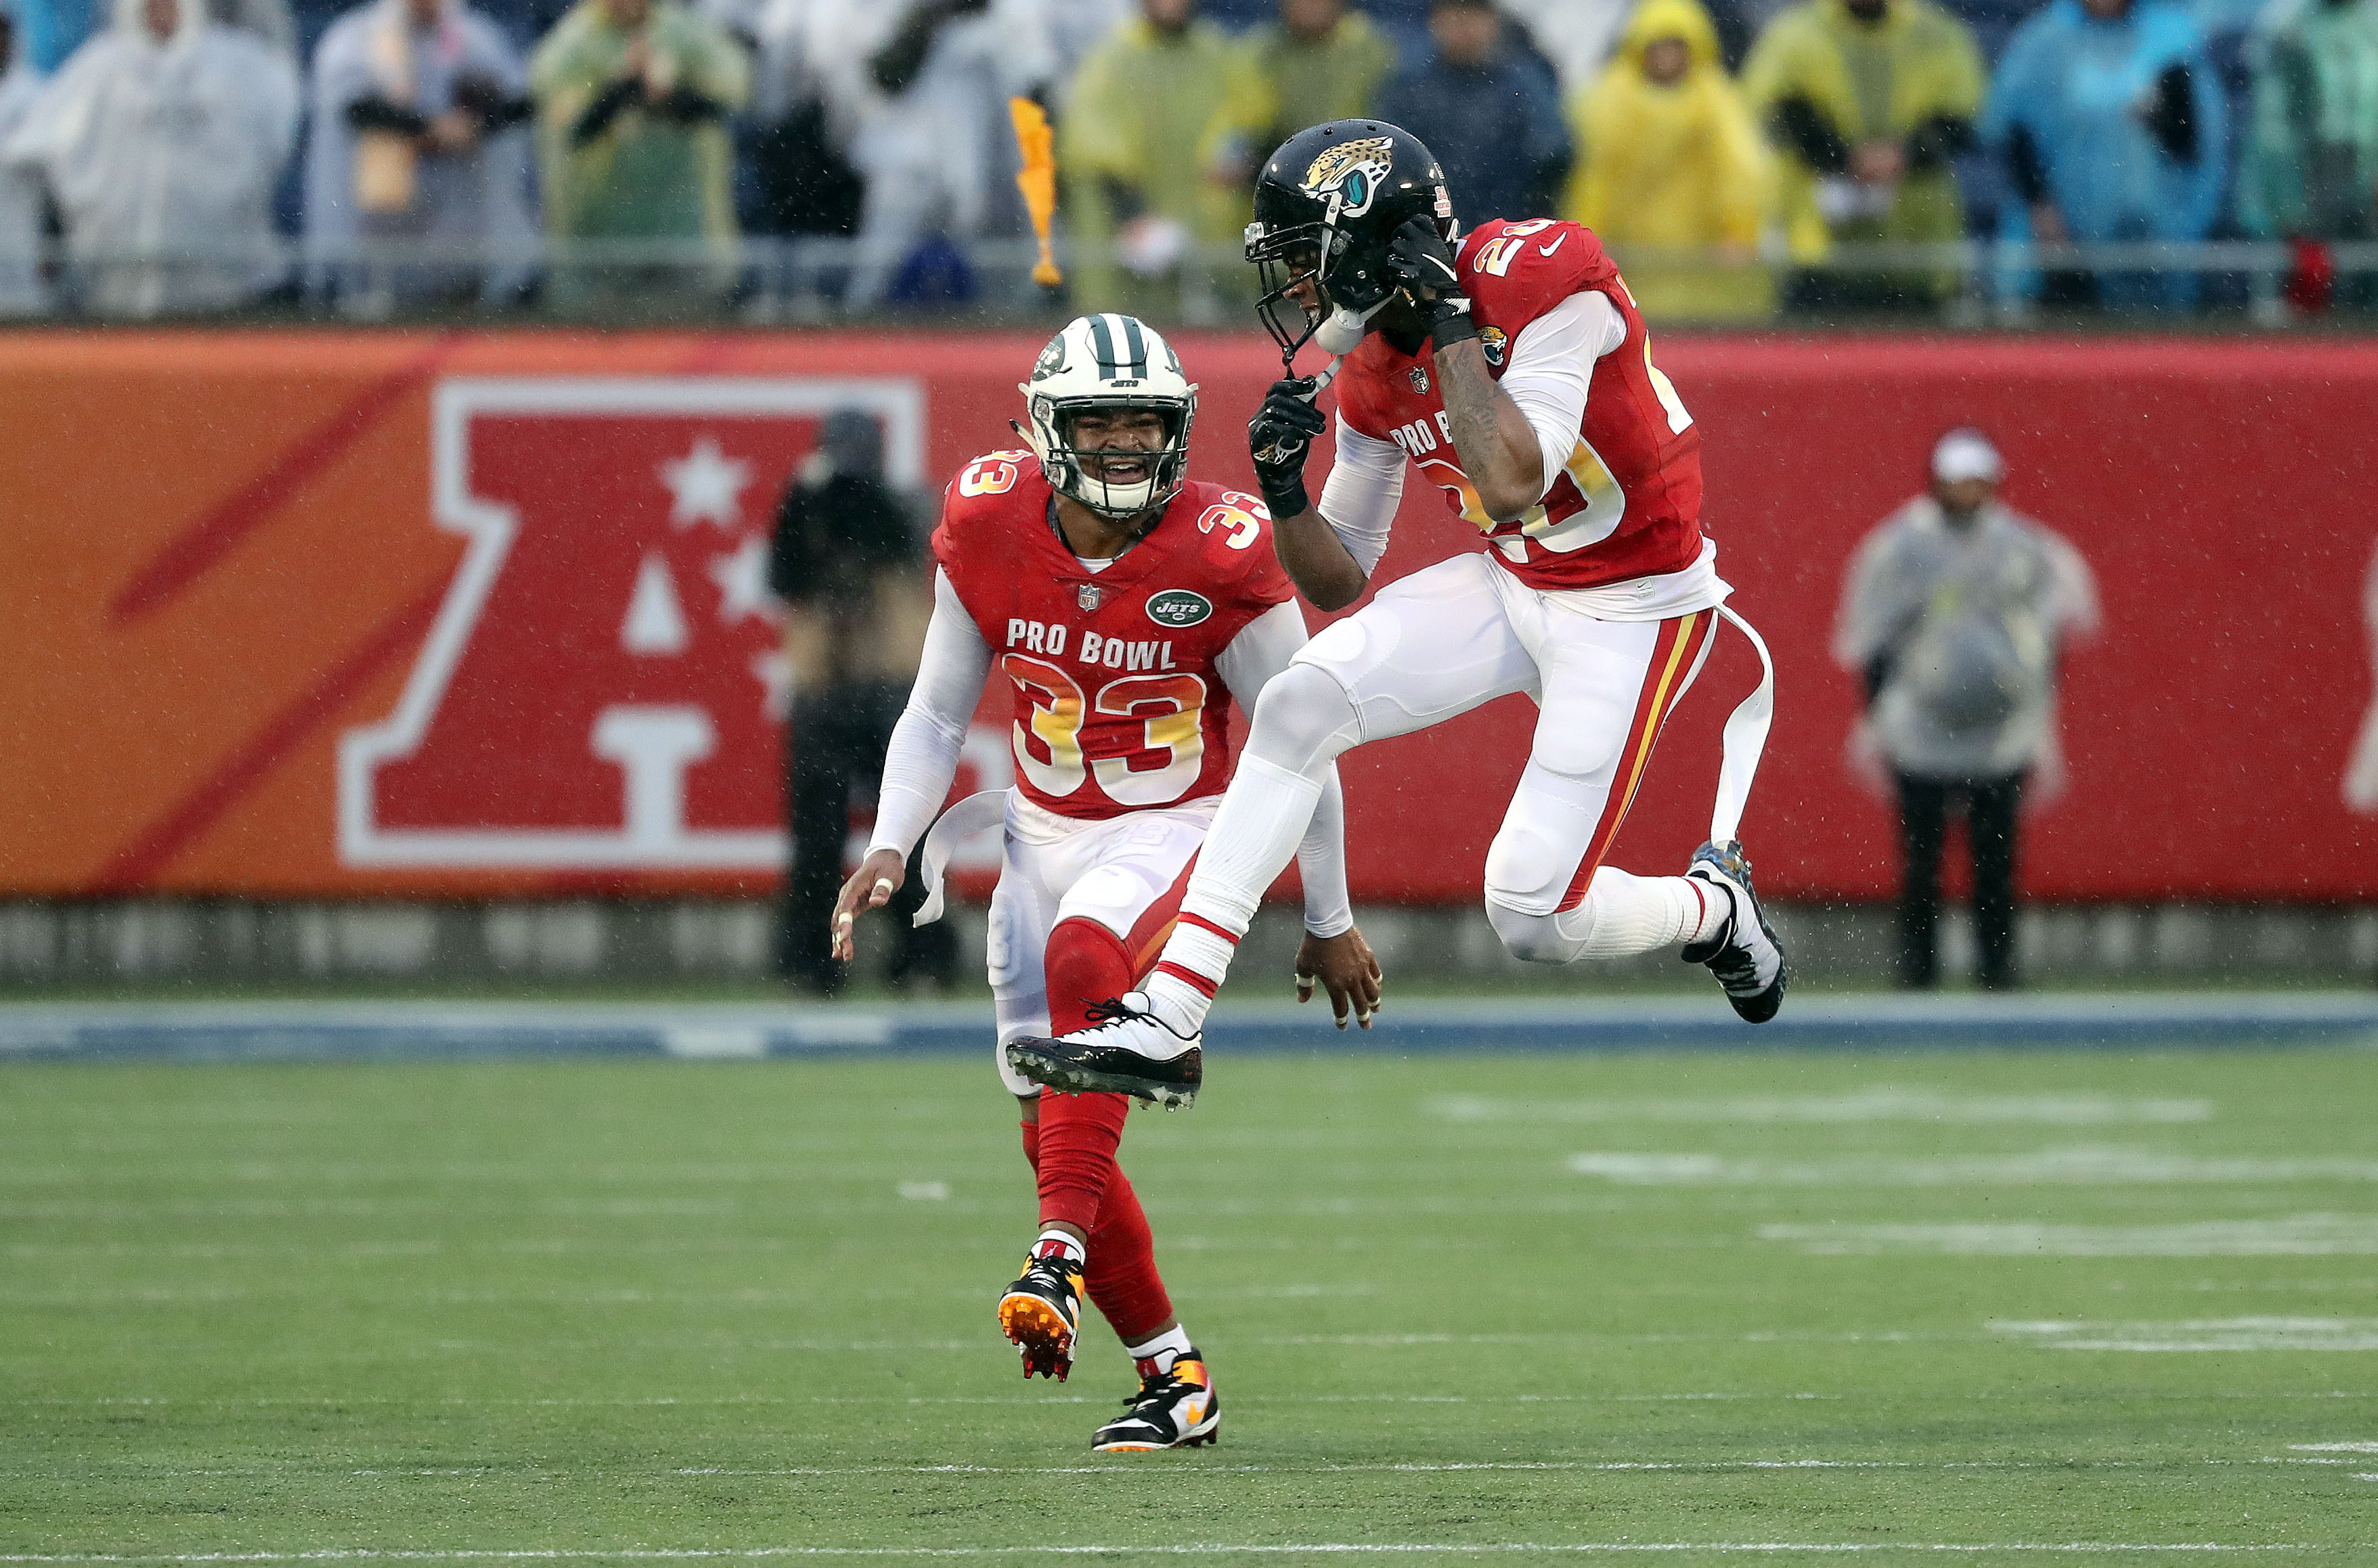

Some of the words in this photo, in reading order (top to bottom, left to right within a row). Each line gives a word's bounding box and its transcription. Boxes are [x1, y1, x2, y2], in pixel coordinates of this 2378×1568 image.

[1473, 219, 1557, 277] 20
[1389, 419, 1436, 456] PRO
[1155, 602, 1200, 613] JETS
[1007, 618, 1067, 656] PRO
[1078, 630, 1176, 671] BOWL
[1001, 652, 1208, 807] 33
